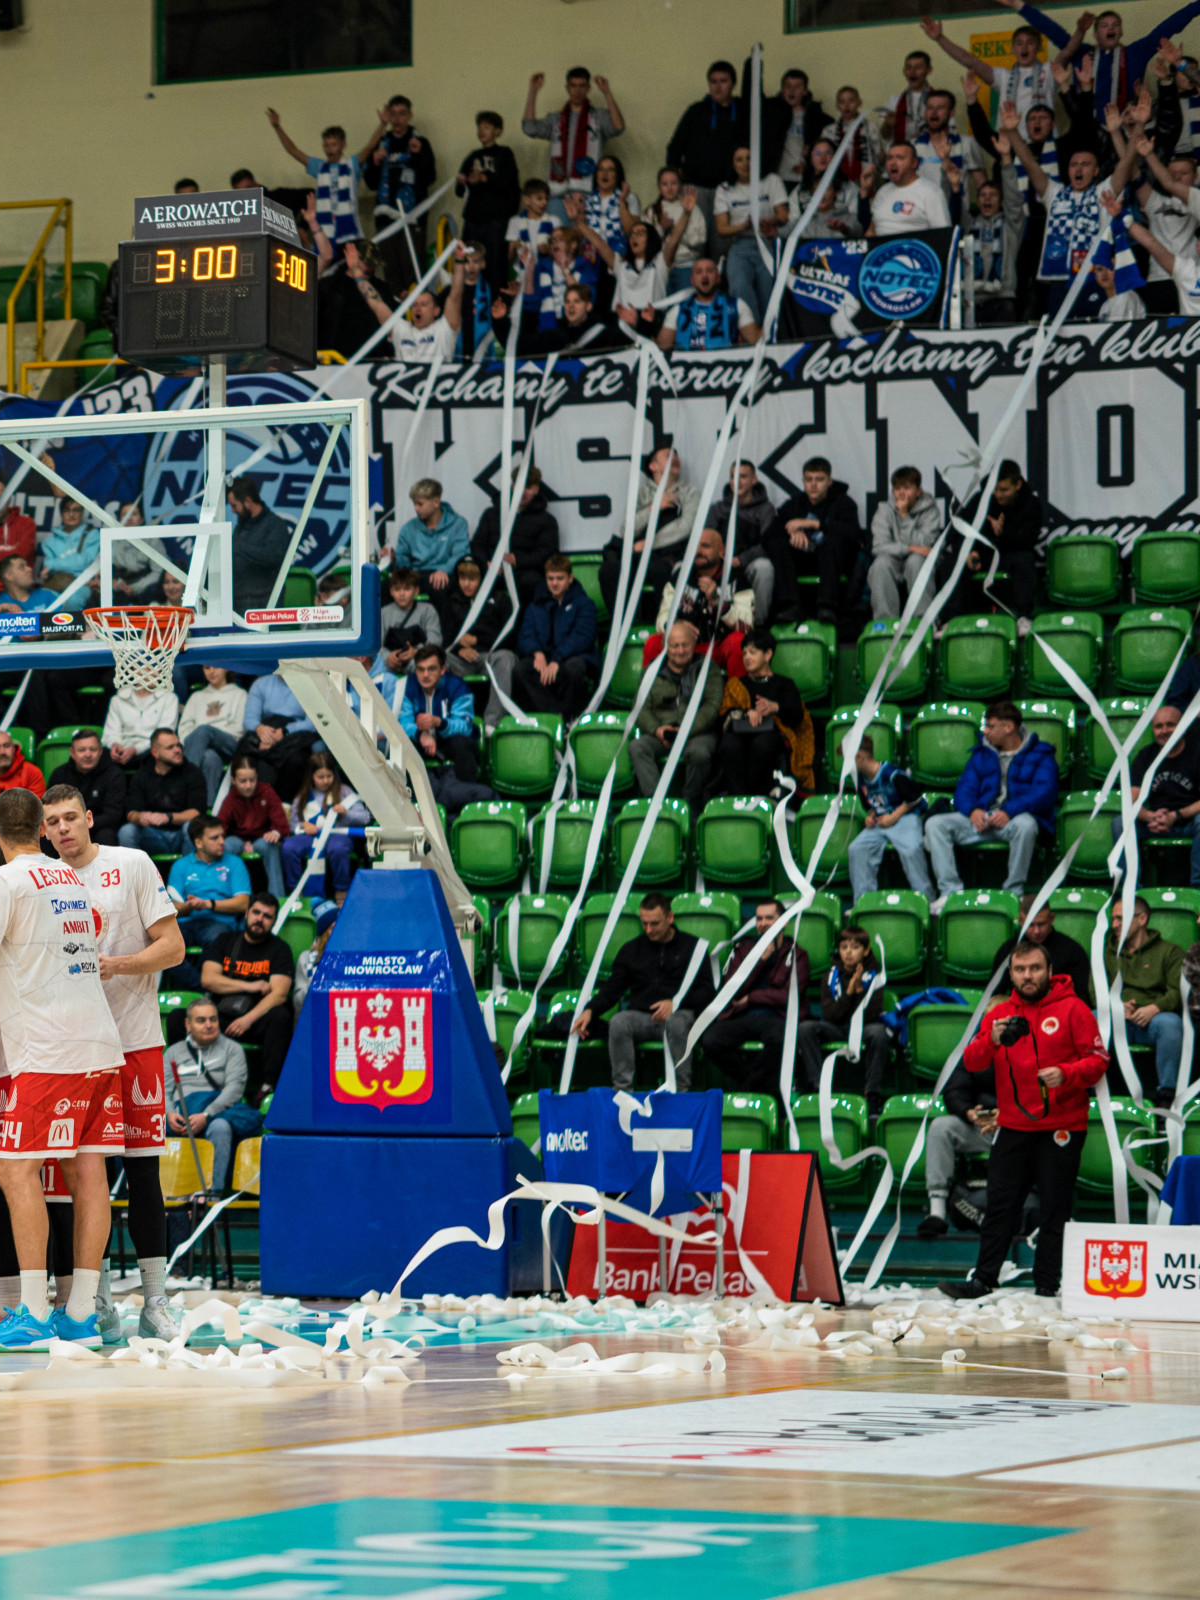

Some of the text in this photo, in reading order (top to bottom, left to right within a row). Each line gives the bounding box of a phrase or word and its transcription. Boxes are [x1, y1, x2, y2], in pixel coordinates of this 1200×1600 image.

[139, 199, 258, 224] AEROWATCH
[156, 221, 176, 230] SWISS
[176, 219, 206, 228] WATCHES
[227, 216, 241, 224] 1910
[155, 245, 237, 283] 3:00
[275, 248, 307, 292] 3:00
[583, 364, 624, 397] te
[802, 328, 998, 386] kochamy
[277, 612, 295, 620] Pekao
[42, 624, 84, 634] SMJSPORT.PL
[101, 868, 121, 888] 33
[51, 899, 87, 914] NOVIMEX
[63, 920, 90, 935] AMBIT
[362, 955, 406, 965] MIASTO
[344, 965, 423, 975] INOWROCŁAW
[1164, 1253, 1200, 1269] MI
[592, 1261, 661, 1291] Bank
[1155, 1273, 1200, 1290] WS
